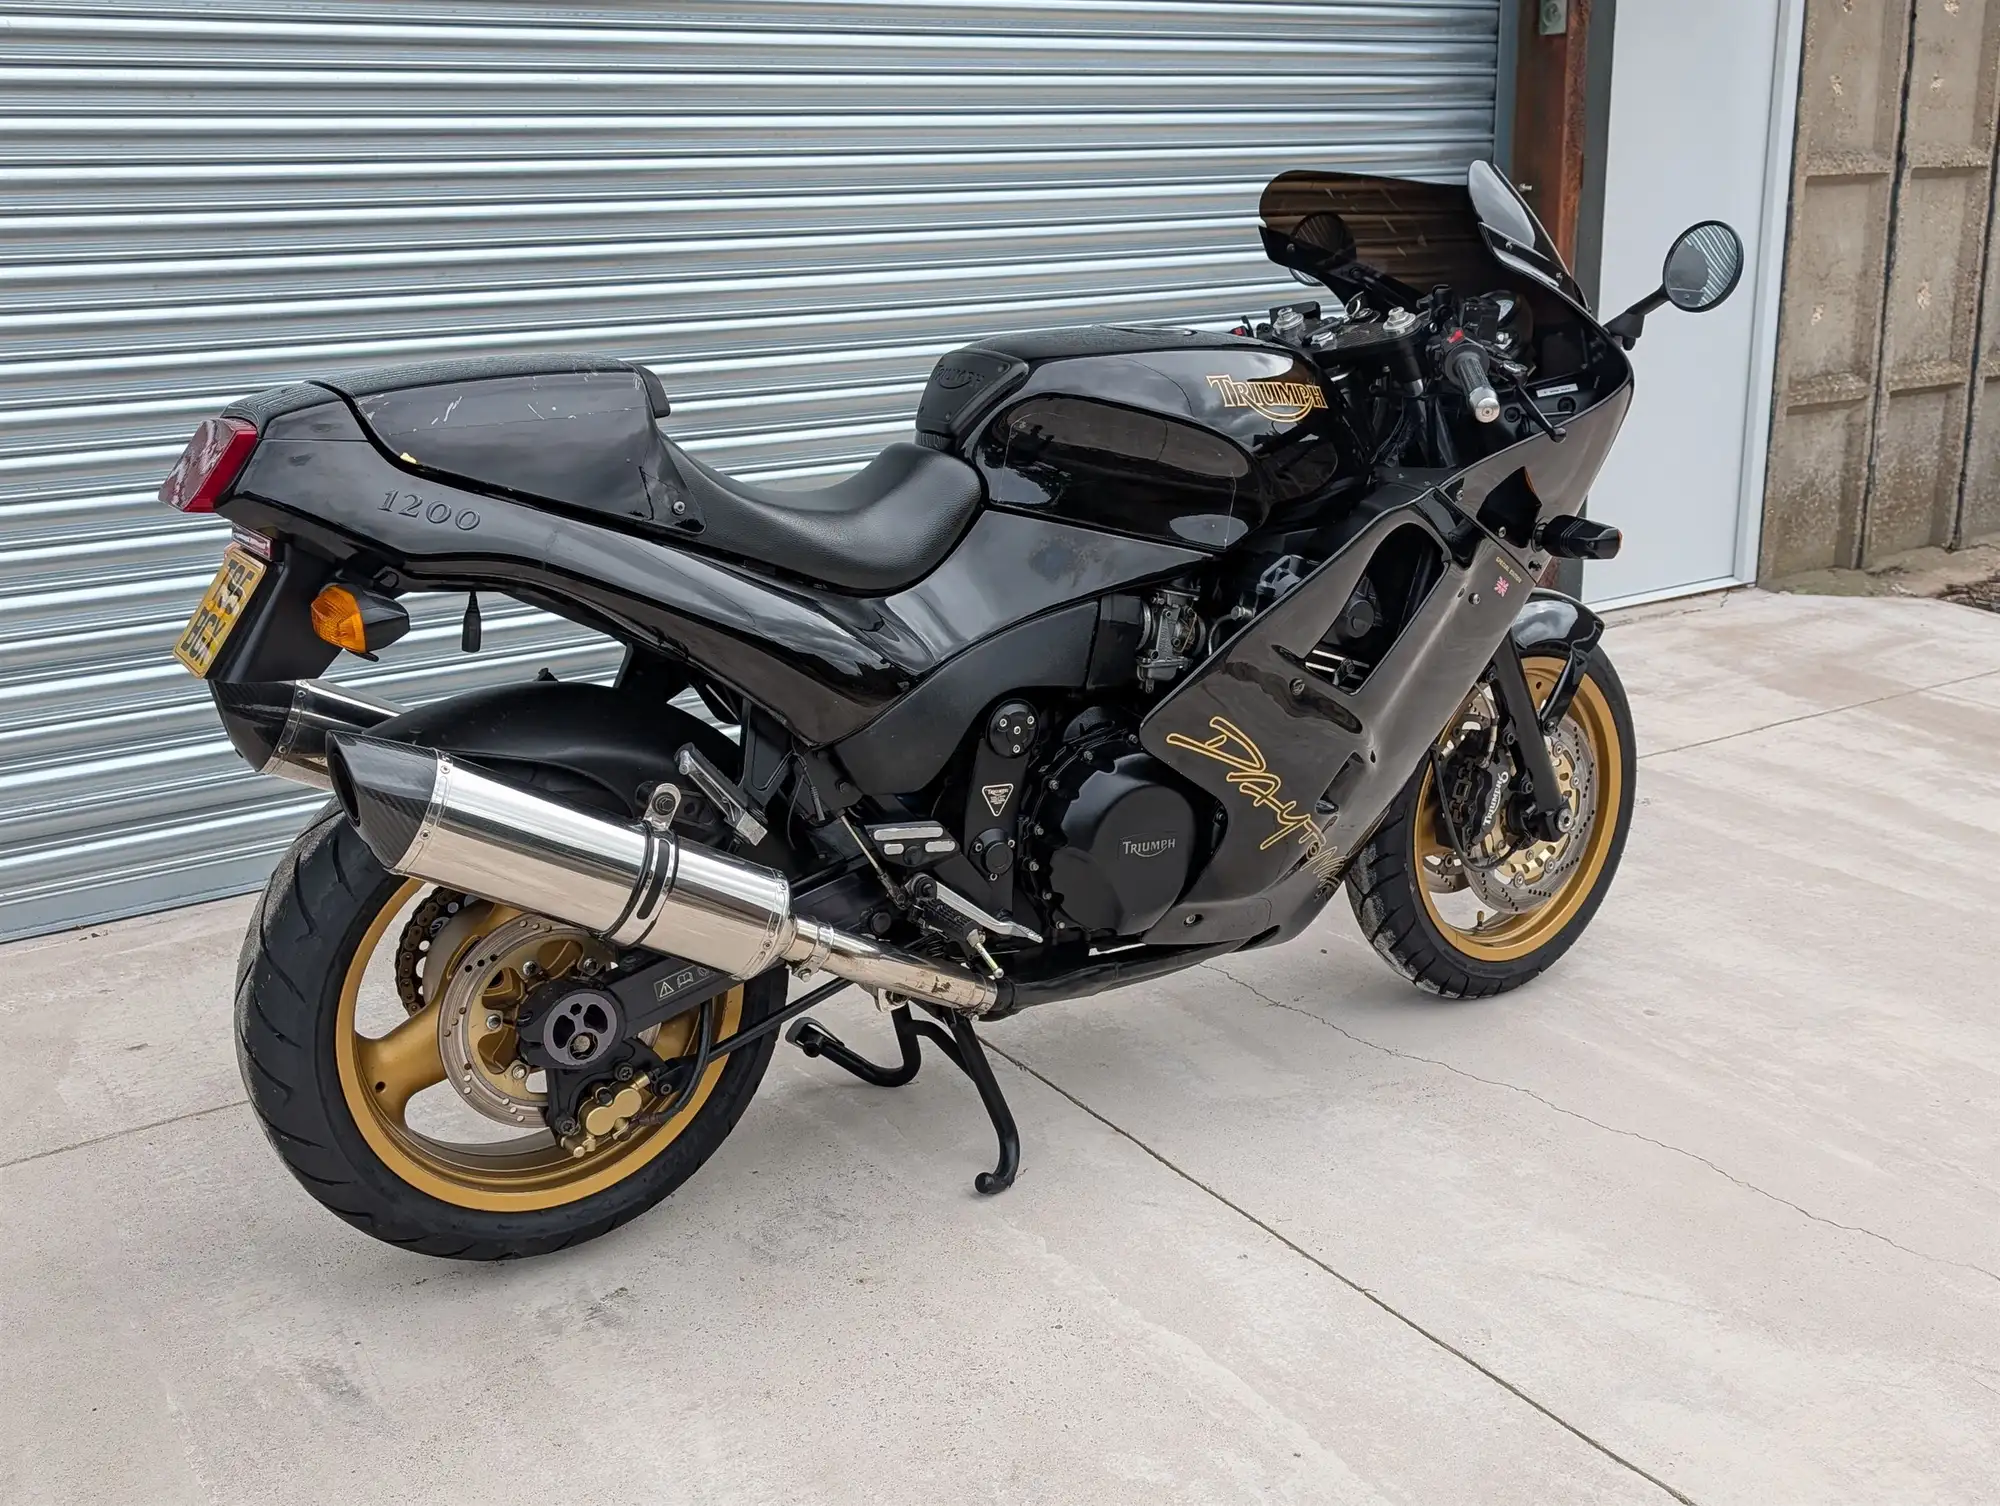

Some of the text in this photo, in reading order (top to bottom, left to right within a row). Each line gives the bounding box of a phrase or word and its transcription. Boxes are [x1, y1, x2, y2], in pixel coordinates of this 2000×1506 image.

[1206, 374, 1329, 422] TRIUMPH
[377, 488, 480, 531] 1200
[1482, 779, 1503, 826] TRIUMPH
[1122, 838, 1176, 858] TRIUMPH
